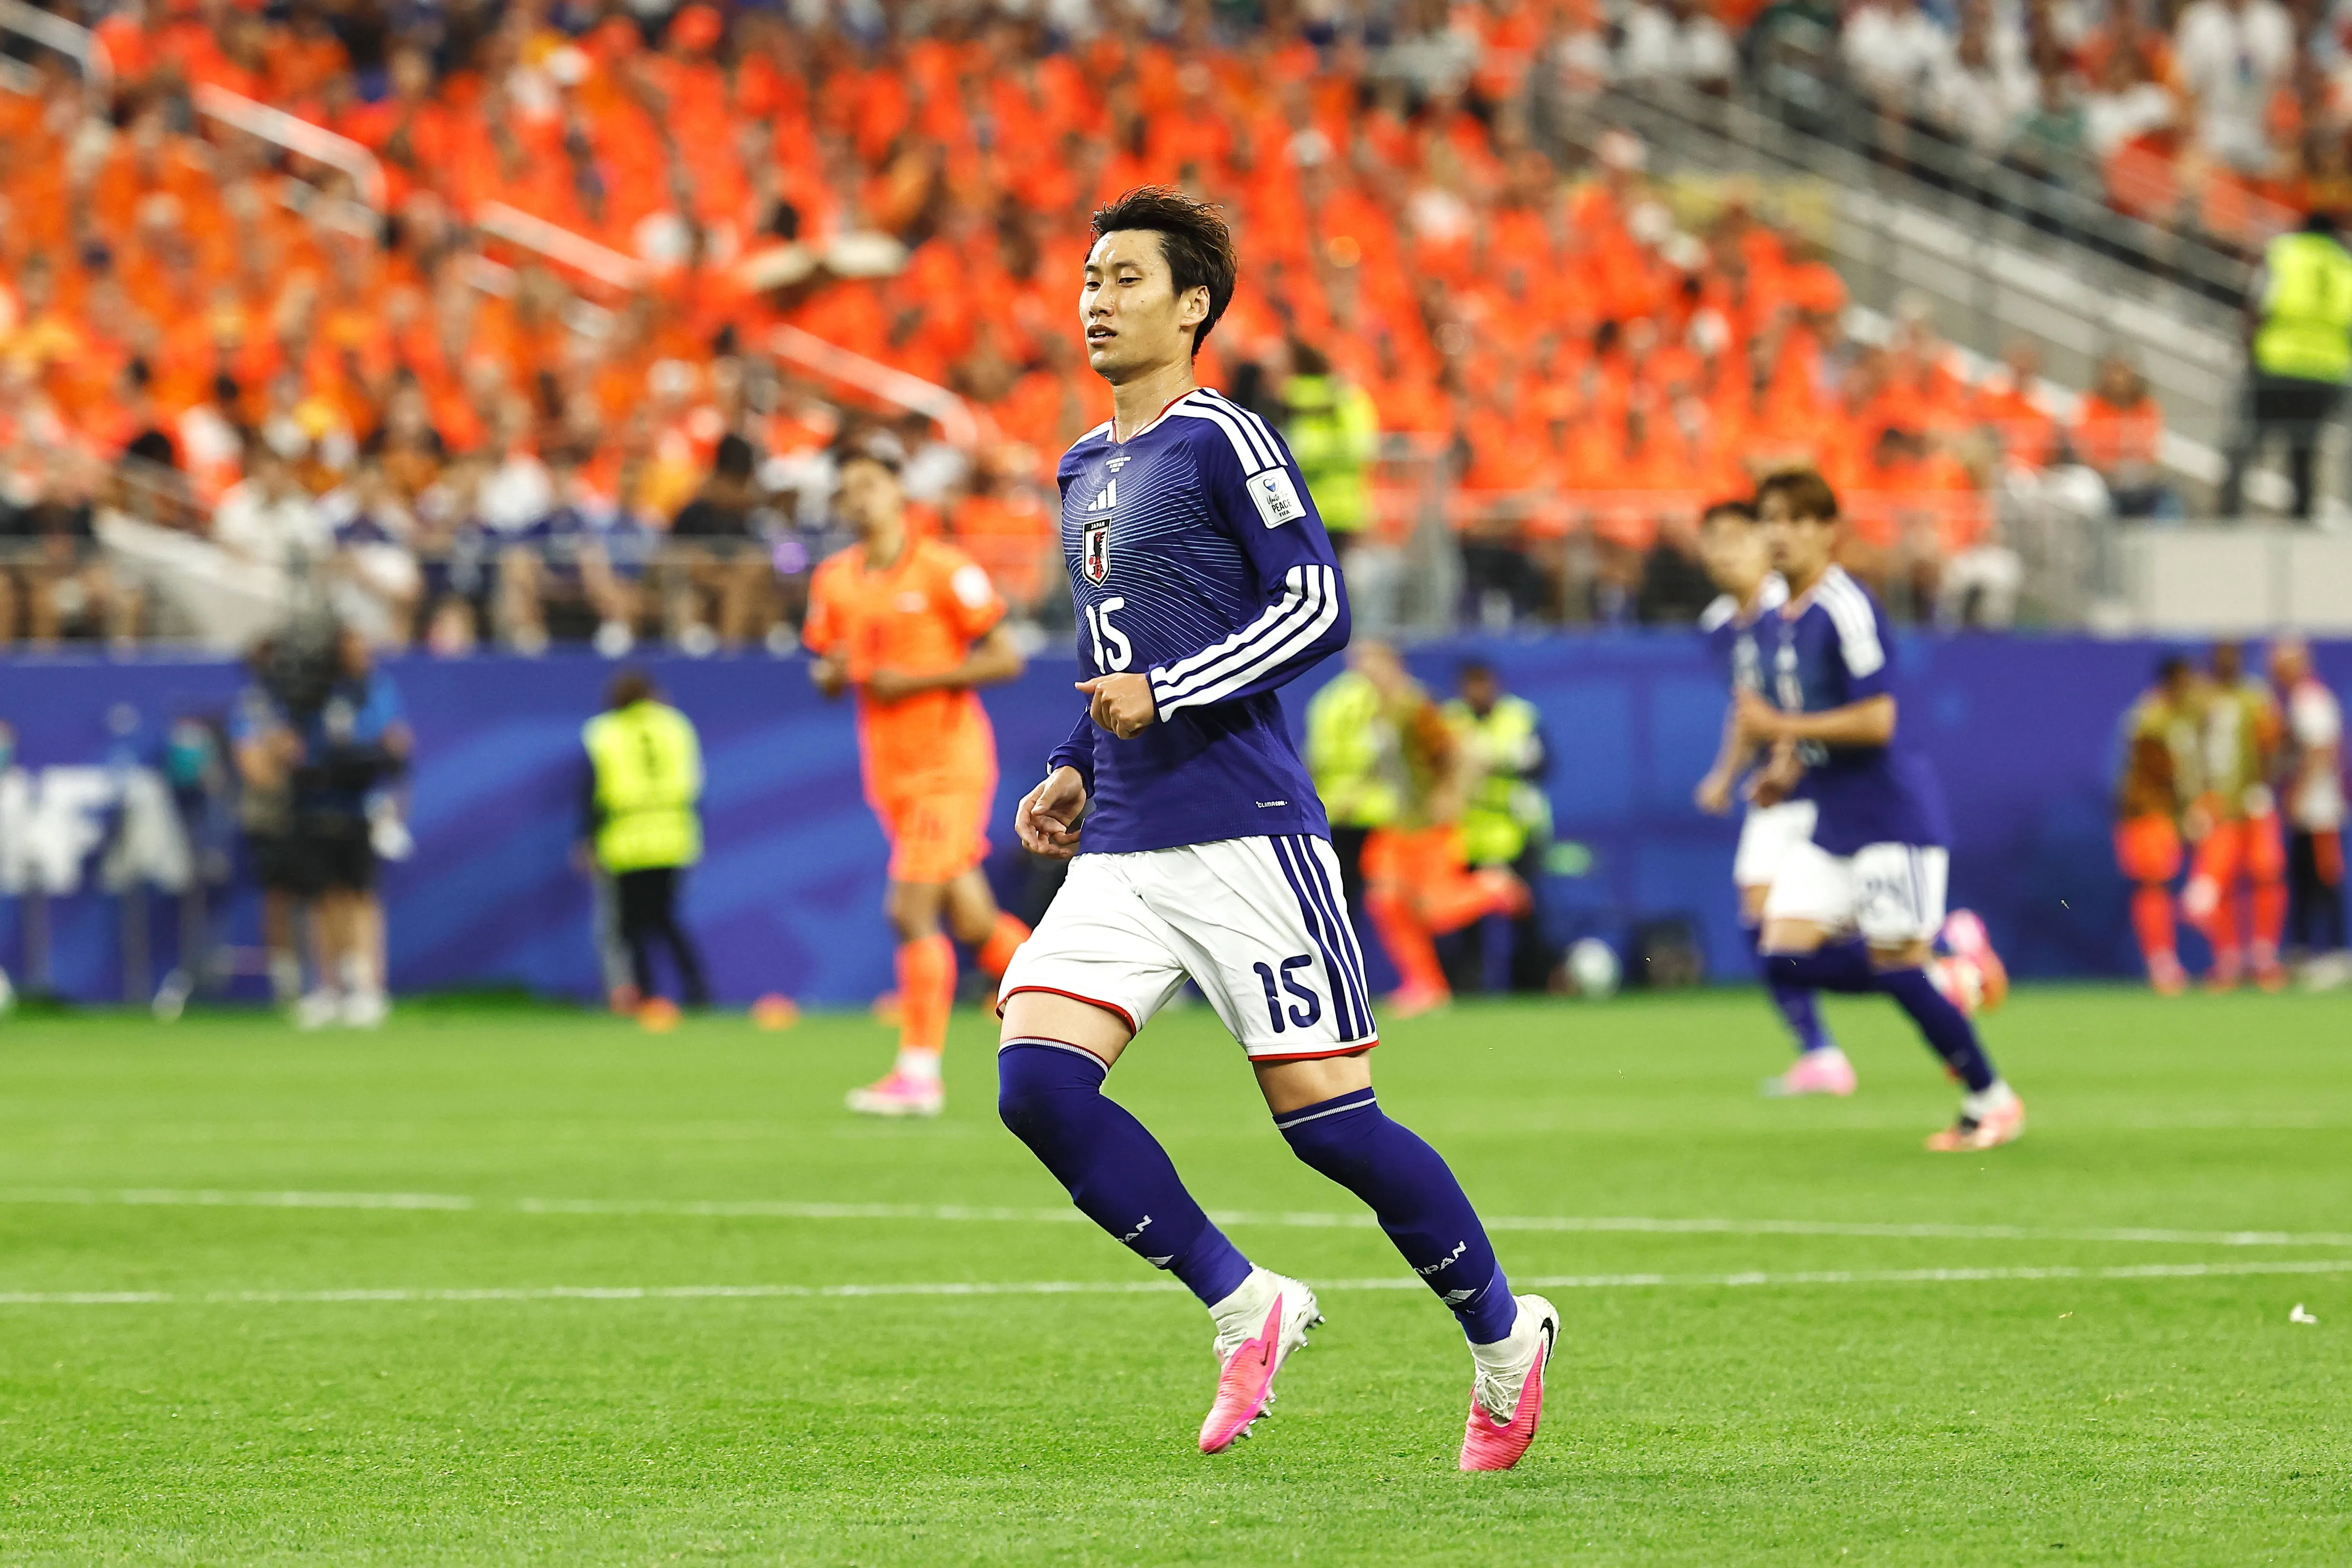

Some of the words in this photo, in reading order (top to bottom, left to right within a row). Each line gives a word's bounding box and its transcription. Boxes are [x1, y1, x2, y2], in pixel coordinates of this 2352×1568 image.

[1266, 494, 1281, 505] Unite
[1271, 499, 1292, 513] PEACE
[1090, 521, 1105, 530] JAPAN
[1091, 564, 1104, 576] JFA
[1086, 596, 1132, 674] 15
[1253, 954, 1321, 1033] 15
